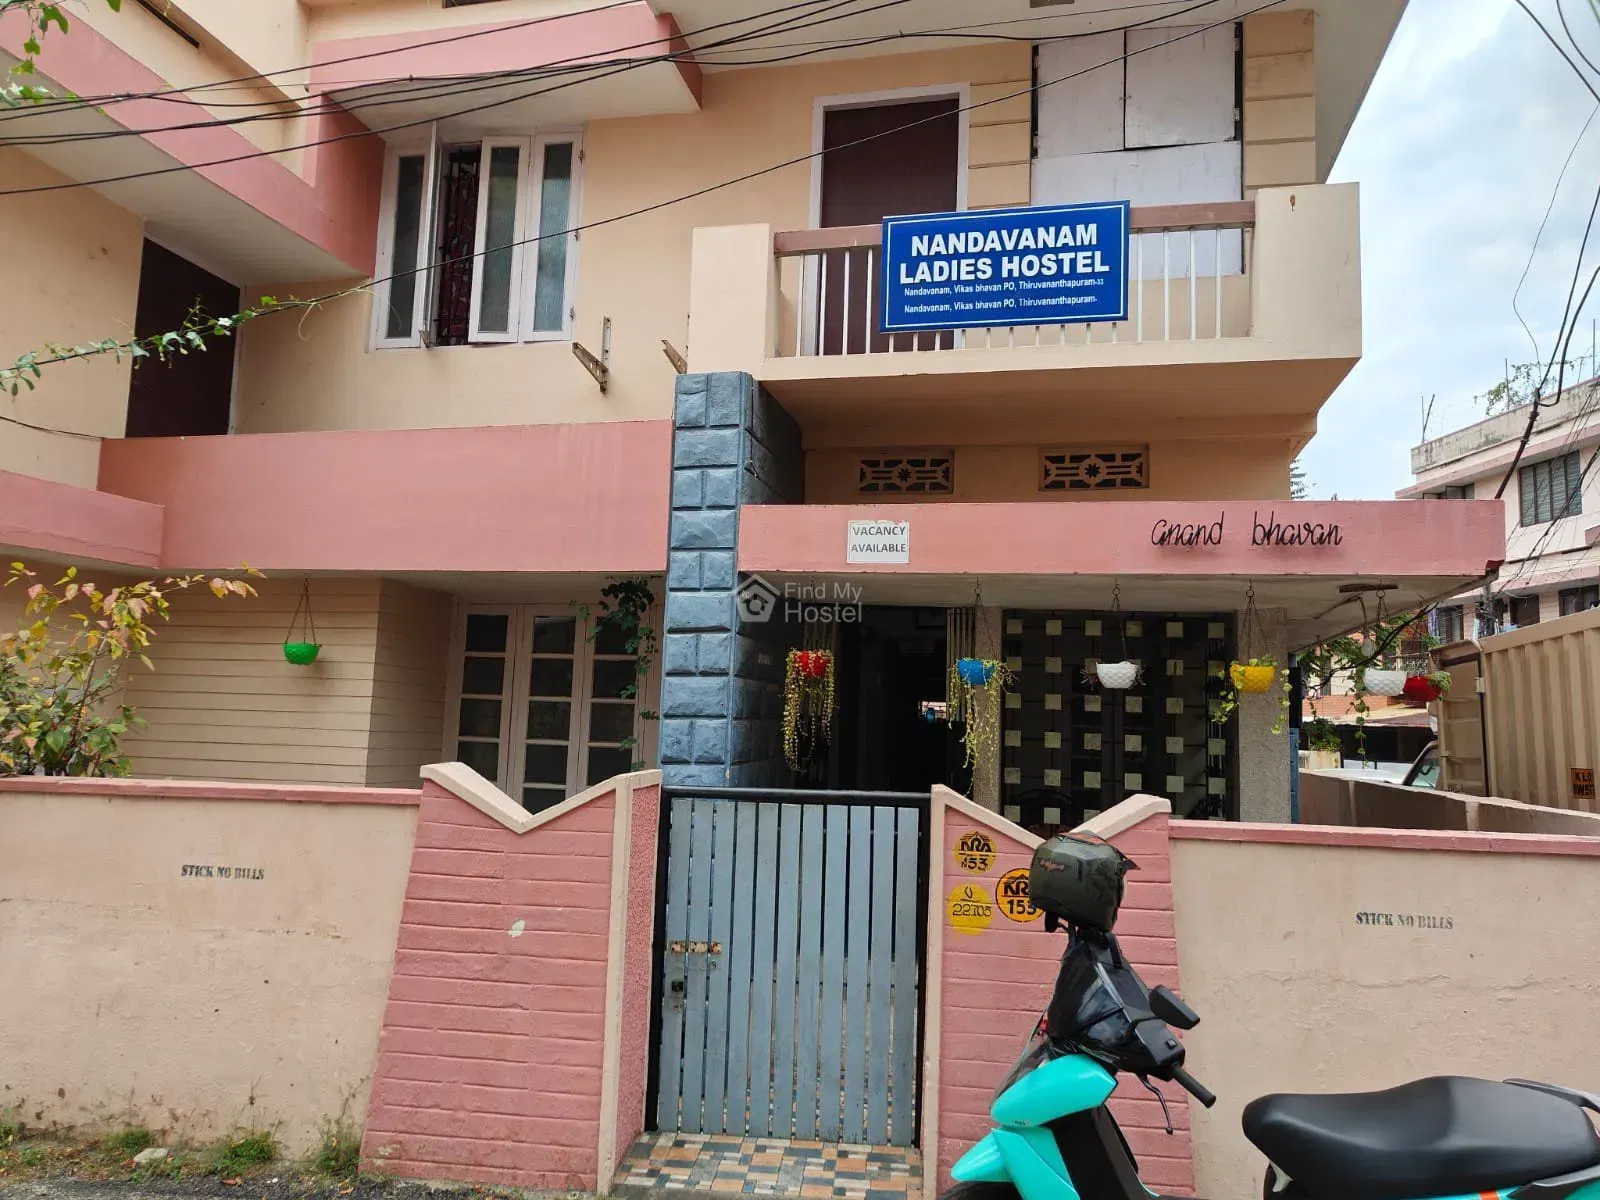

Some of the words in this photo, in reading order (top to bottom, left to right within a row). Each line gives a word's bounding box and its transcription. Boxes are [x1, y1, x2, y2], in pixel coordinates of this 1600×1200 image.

[911, 223, 1098, 257] NANDAVANAM
[900, 257, 993, 285] LADIES
[1001, 251, 1110, 278] HOSTEL
[904, 286, 952, 297] Nandavanam,
[954, 284, 973, 293] Vikas
[975, 283, 1002, 293] bhavan
[1003, 281, 1017, 292] PO,
[904, 303, 952, 314] Nandavanam,
[954, 301, 973, 310] Vikas
[975, 300, 1002, 310] bhavan
[1003, 298, 1017, 309] PO,
[852, 526, 906, 536] VACANCY
[1252, 511, 1343, 546] bhavan
[851, 543, 906, 553] AVAILABLE
[181, 864, 214, 878] STICK
[217, 866, 232, 879] NO
[1356, 912, 1394, 926] STICK
[1398, 914, 1414, 928] NO
